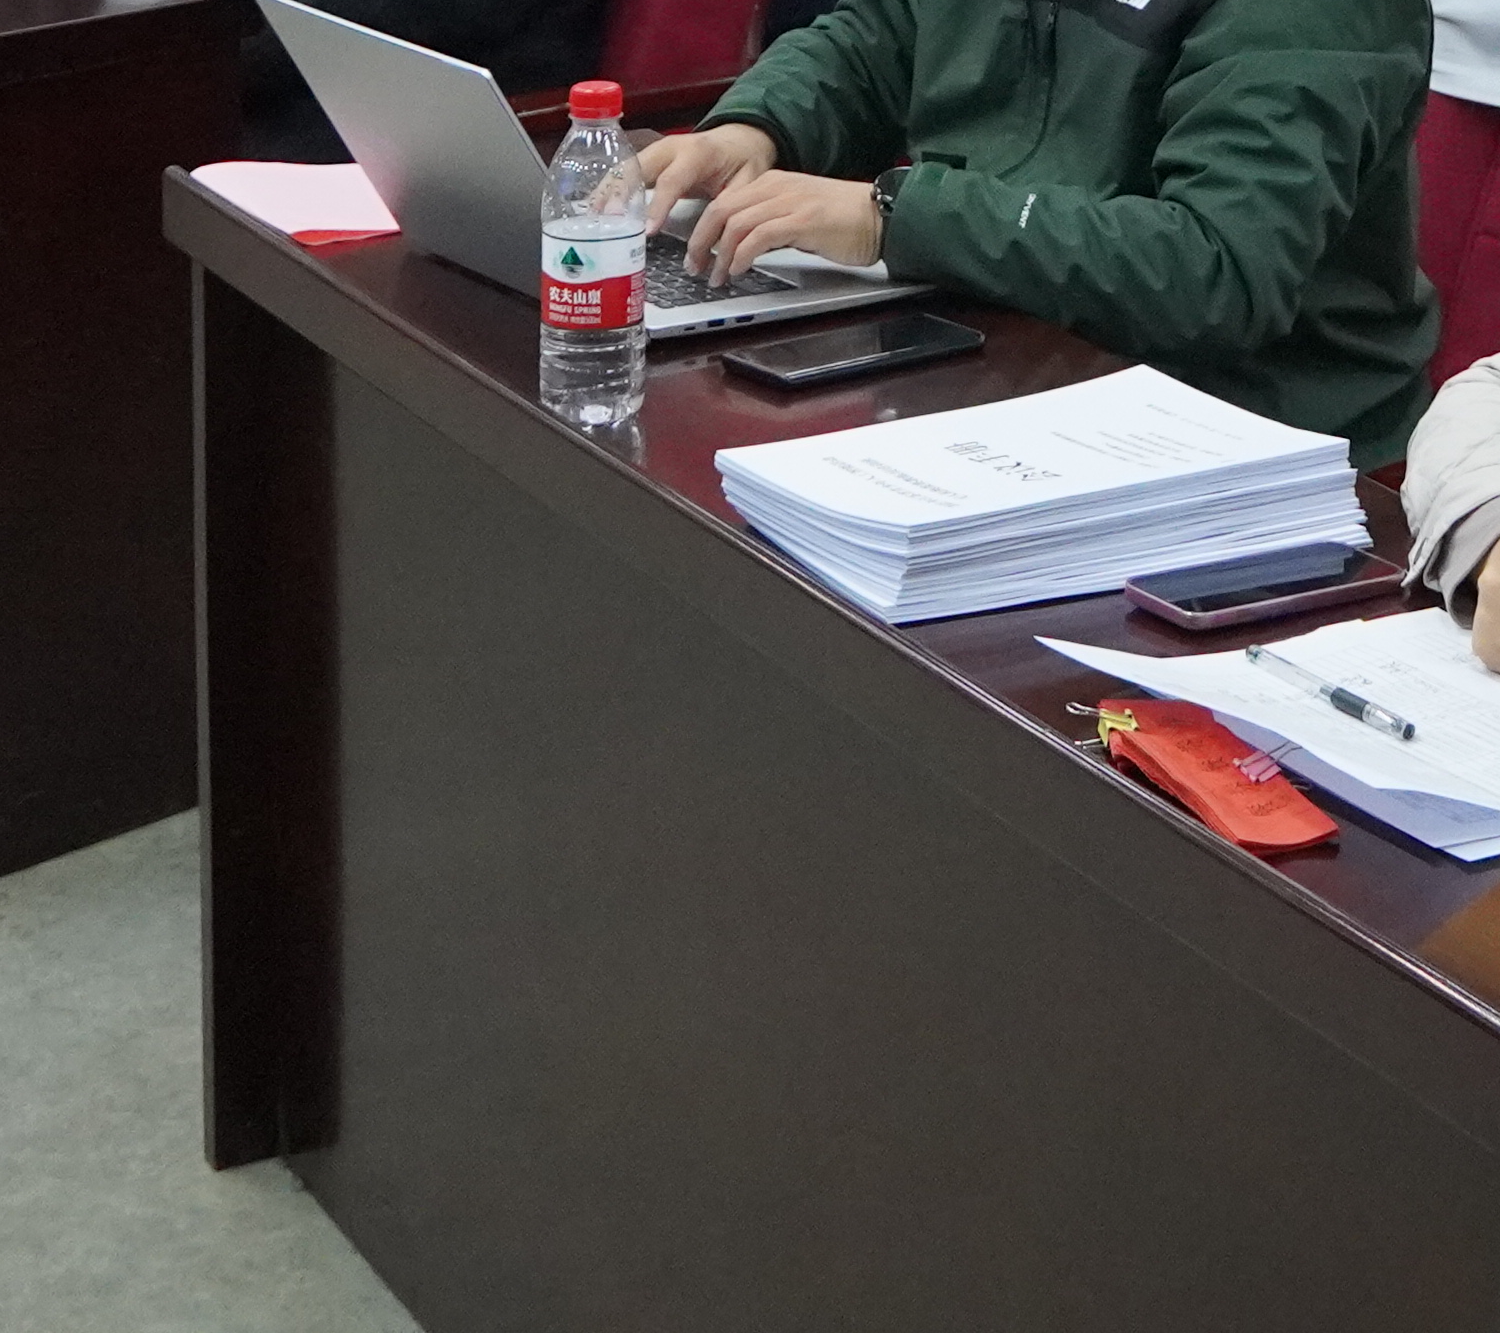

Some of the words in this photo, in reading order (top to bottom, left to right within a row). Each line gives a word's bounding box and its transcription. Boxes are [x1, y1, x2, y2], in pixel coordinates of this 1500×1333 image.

[549, 286, 602, 305] 农夫山泉
[944, 441, 1062, 482] 会议手册
